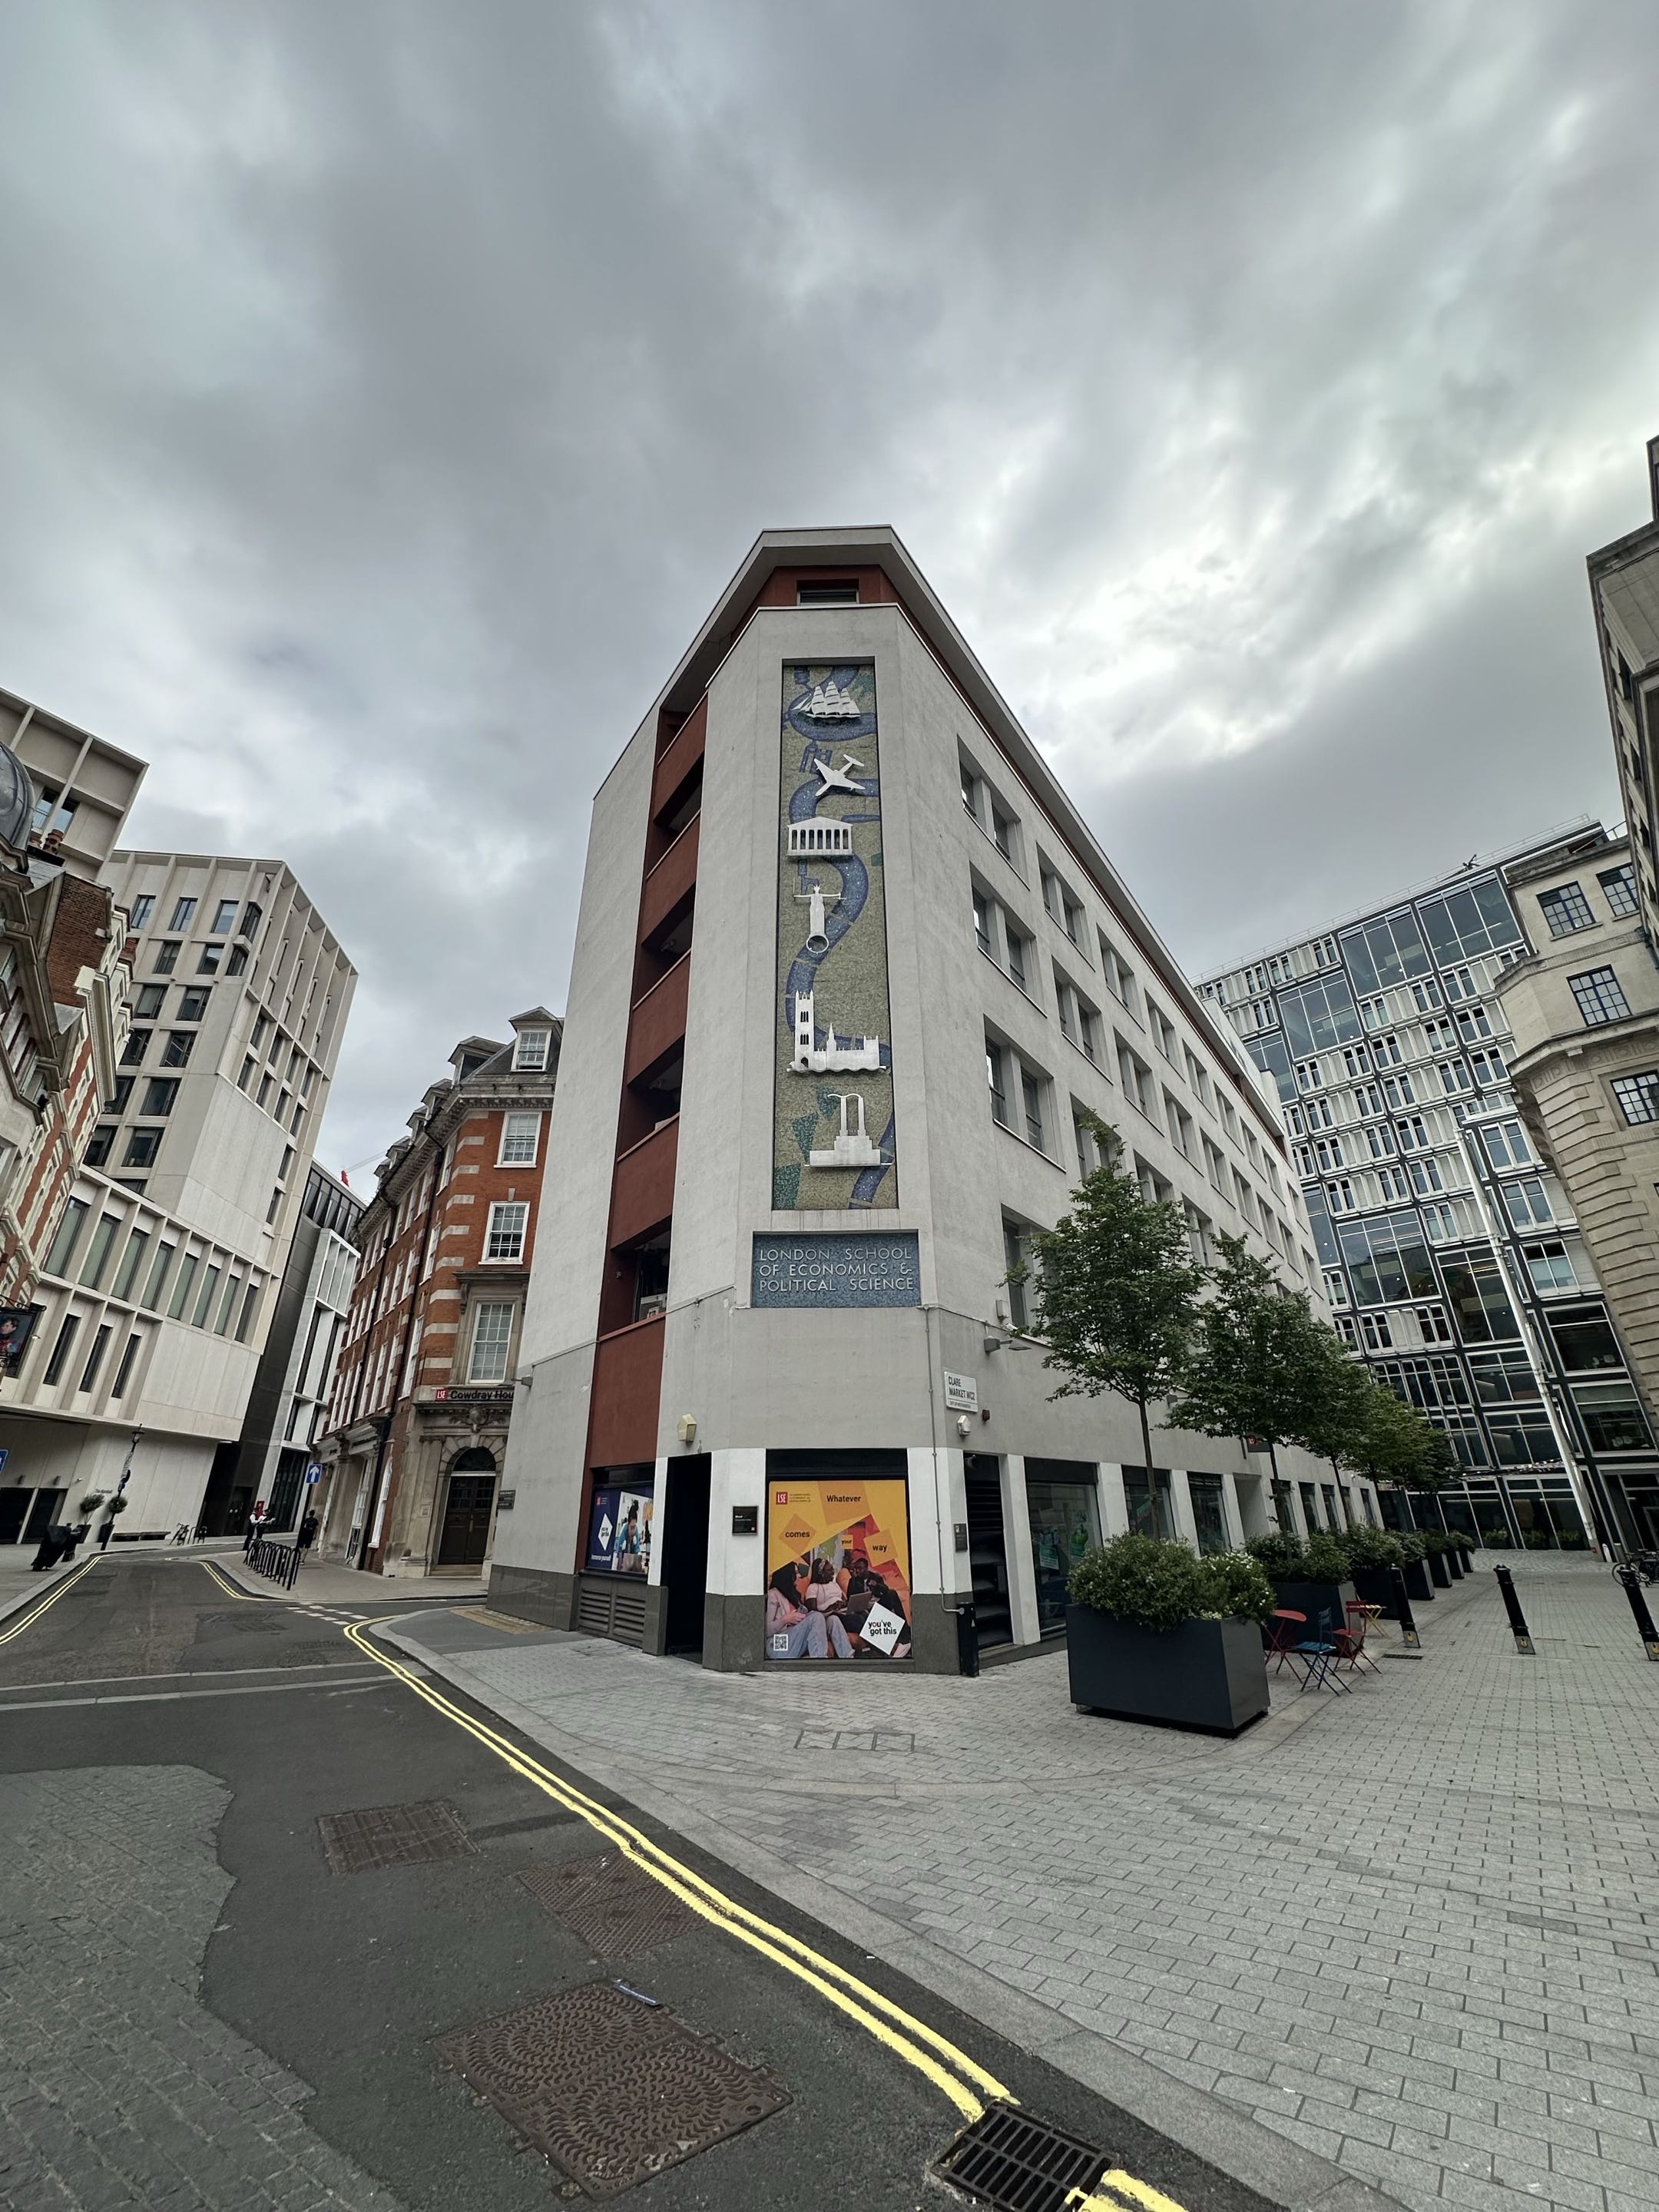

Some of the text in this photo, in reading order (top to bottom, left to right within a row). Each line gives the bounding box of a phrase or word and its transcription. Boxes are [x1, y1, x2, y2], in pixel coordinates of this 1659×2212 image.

[759, 1247, 912, 1261] LONDON SCHOOL
[759, 1263, 912, 1277] OF ECONOMICS &
[760, 1277, 914, 1292] POLITICAL SCIENCE
[948, 1376, 961, 1387] CLARE
[437, 1390, 445, 1399] LSE
[450, 1389, 492, 1401] Cowdray
[949, 1387, 965, 1398] MARKET
[777, 1493, 786, 1503] LSE
[868, 1620, 892, 1629] you've
[870, 1628, 882, 1637] got
